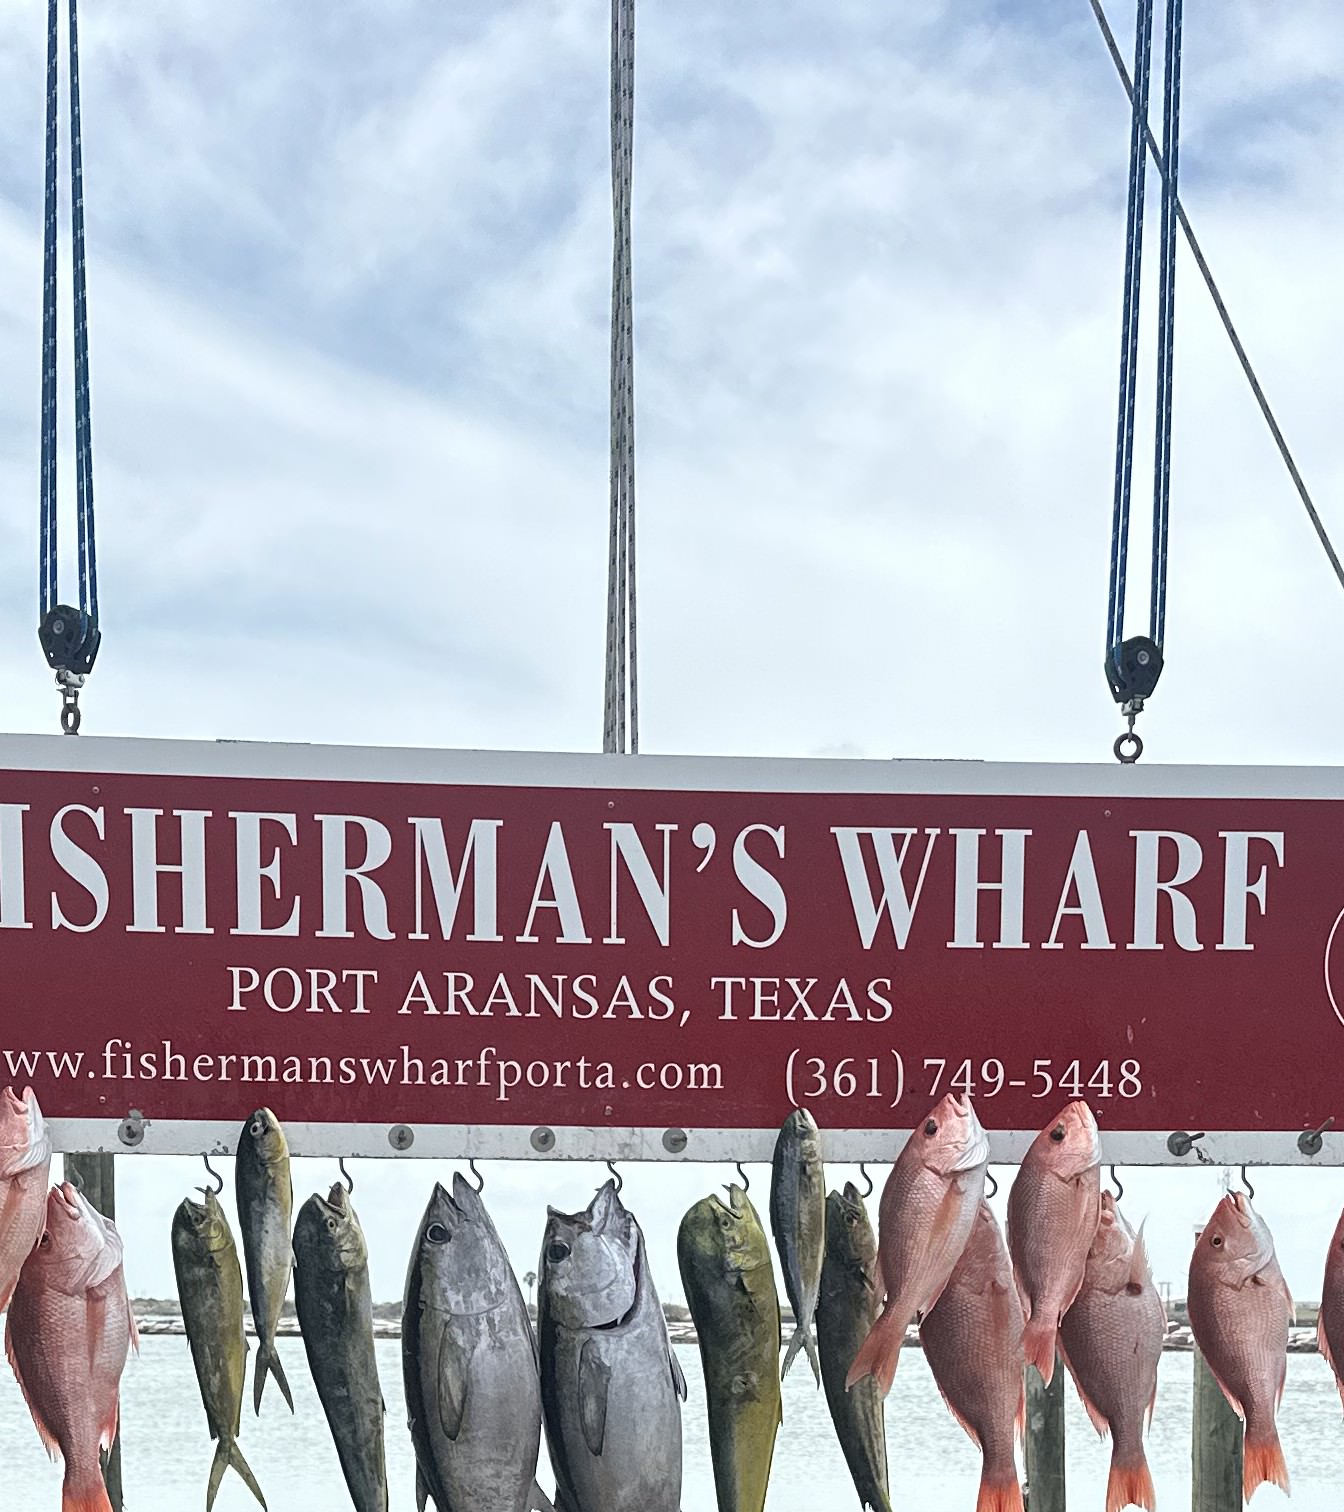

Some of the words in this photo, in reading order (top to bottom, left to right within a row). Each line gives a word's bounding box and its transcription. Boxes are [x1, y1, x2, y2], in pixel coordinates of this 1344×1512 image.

[830, 827, 1284, 951] WHARF
[227, 967, 377, 1013] PORT
[398, 971, 690, 1026] ARANSAS,
[711, 978, 892, 1021] TEXAS
[786, 1049, 904, 1108] (361)
[923, 1058, 1142, 1098] 749-5448
